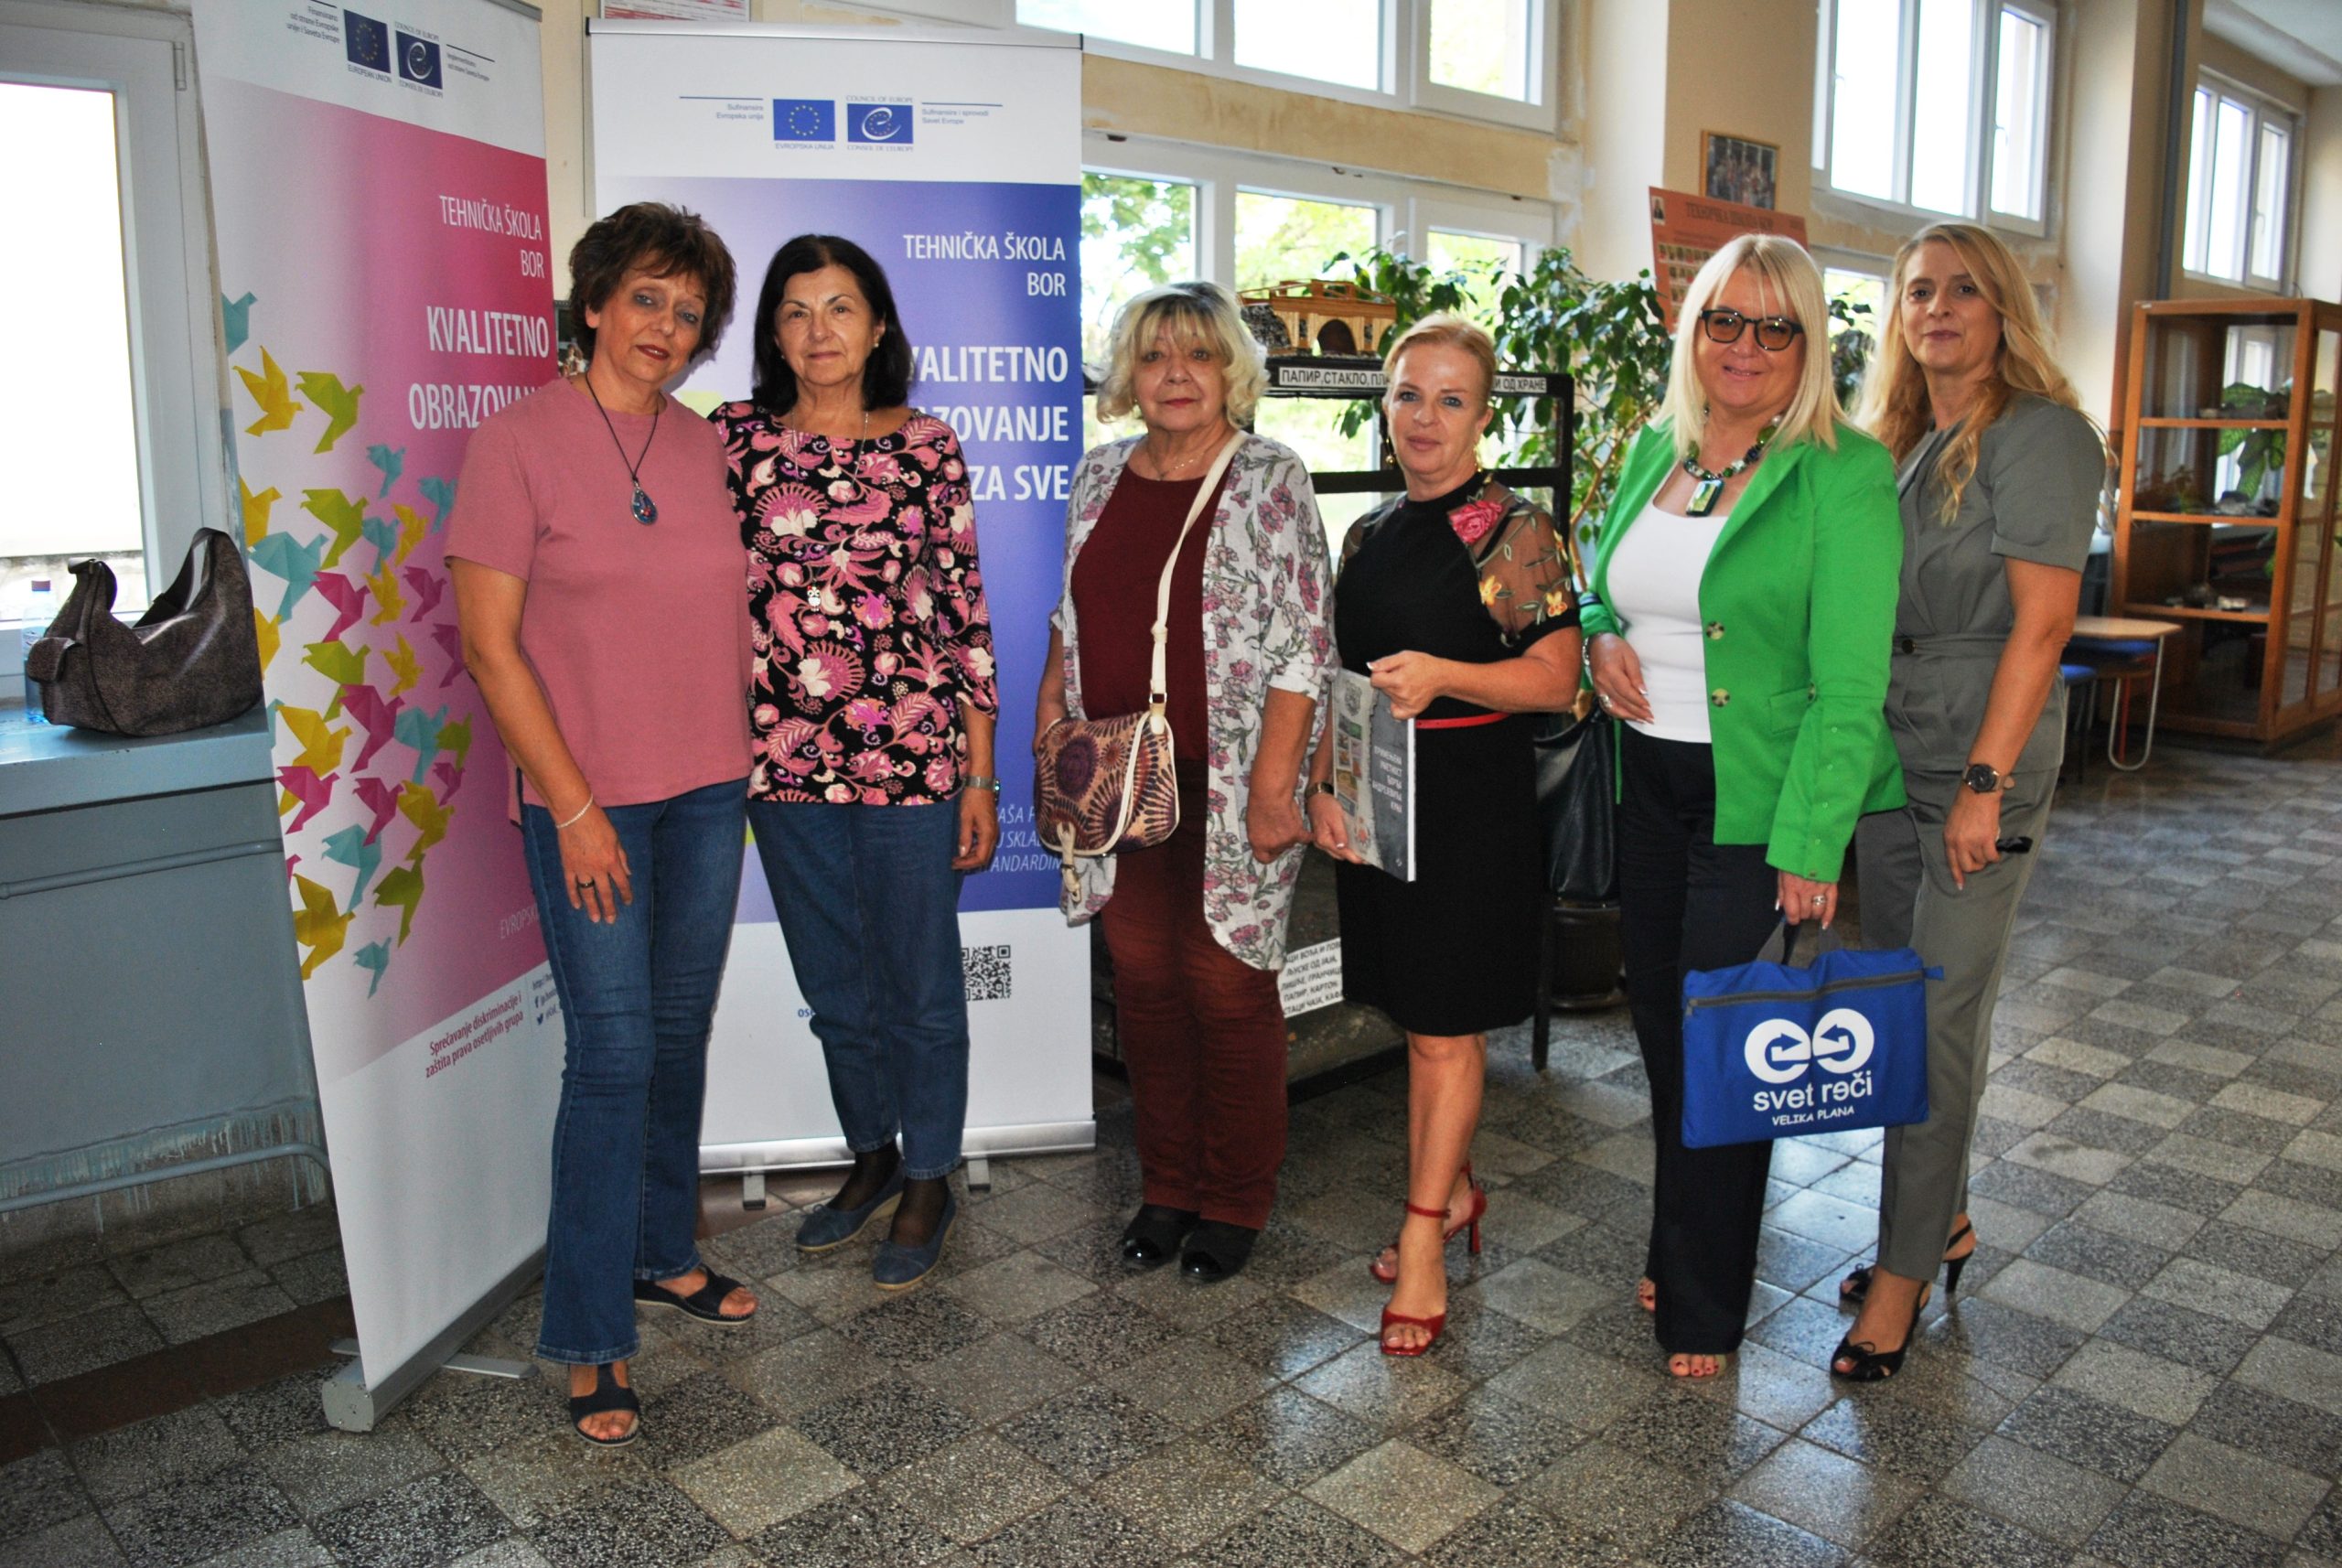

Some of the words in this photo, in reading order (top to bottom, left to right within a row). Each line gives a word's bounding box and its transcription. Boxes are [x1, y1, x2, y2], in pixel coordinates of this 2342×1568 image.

[348, 64, 375, 80] EUROPEAN
[375, 72, 392, 84] UNION
[845, 94, 876, 102] COUNCIL
[878, 95, 886, 103] OF
[888, 95, 913, 103] EUROPE
[439, 195, 504, 234] TEHNIČKA
[505, 203, 543, 241] ŠKOLA
[903, 231, 999, 260] TEHNIČKA
[1004, 231, 1066, 261] ŠKOLA
[520, 249, 545, 278] BOR
[1026, 272, 1067, 296] BOR
[426, 306, 550, 359] KVALITETNO
[1517, 378, 1546, 391] ХРАНЕ
[970, 465, 1006, 501] ZA
[1014, 465, 1069, 501] SVE
[996, 804, 1024, 823] AŠA
[430, 1022, 472, 1057] Sprečavanje
[472, 995, 519, 1030] diskriminacije
[425, 1055, 451, 1079] zaštita
[452, 1042, 473, 1066] prava
[473, 1021, 504, 1049] osetljivih
[505, 1011, 524, 1034] grupa
[1753, 1082, 1815, 1112] svet
[1771, 1112, 1815, 1126] VELIKA
[1817, 1105, 1855, 1120] PLANA
